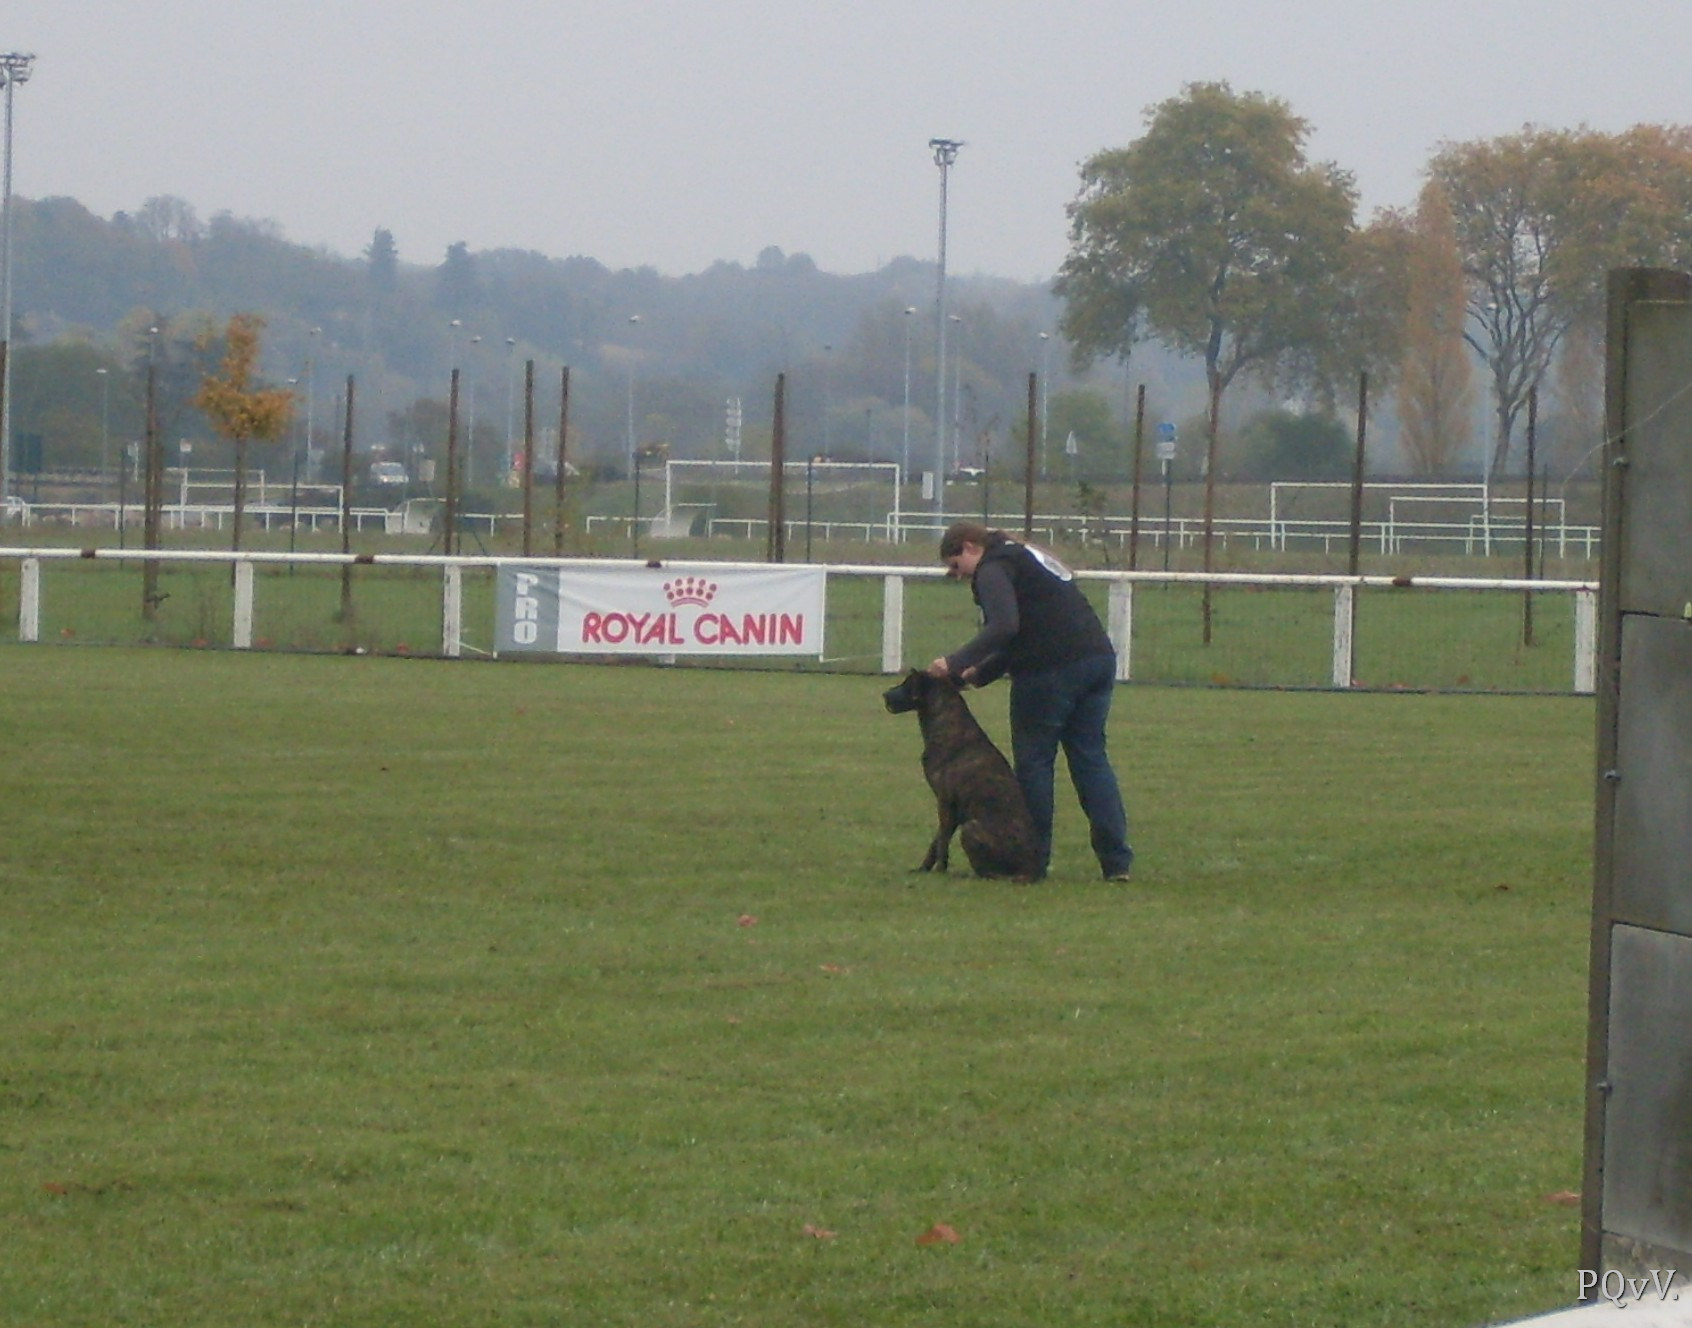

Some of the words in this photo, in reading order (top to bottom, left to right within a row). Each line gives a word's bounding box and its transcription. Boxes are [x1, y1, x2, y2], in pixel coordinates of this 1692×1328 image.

[513, 573, 539, 644] PRO
[582, 612, 684, 645] ROYAL
[693, 613, 803, 645] CANIN
